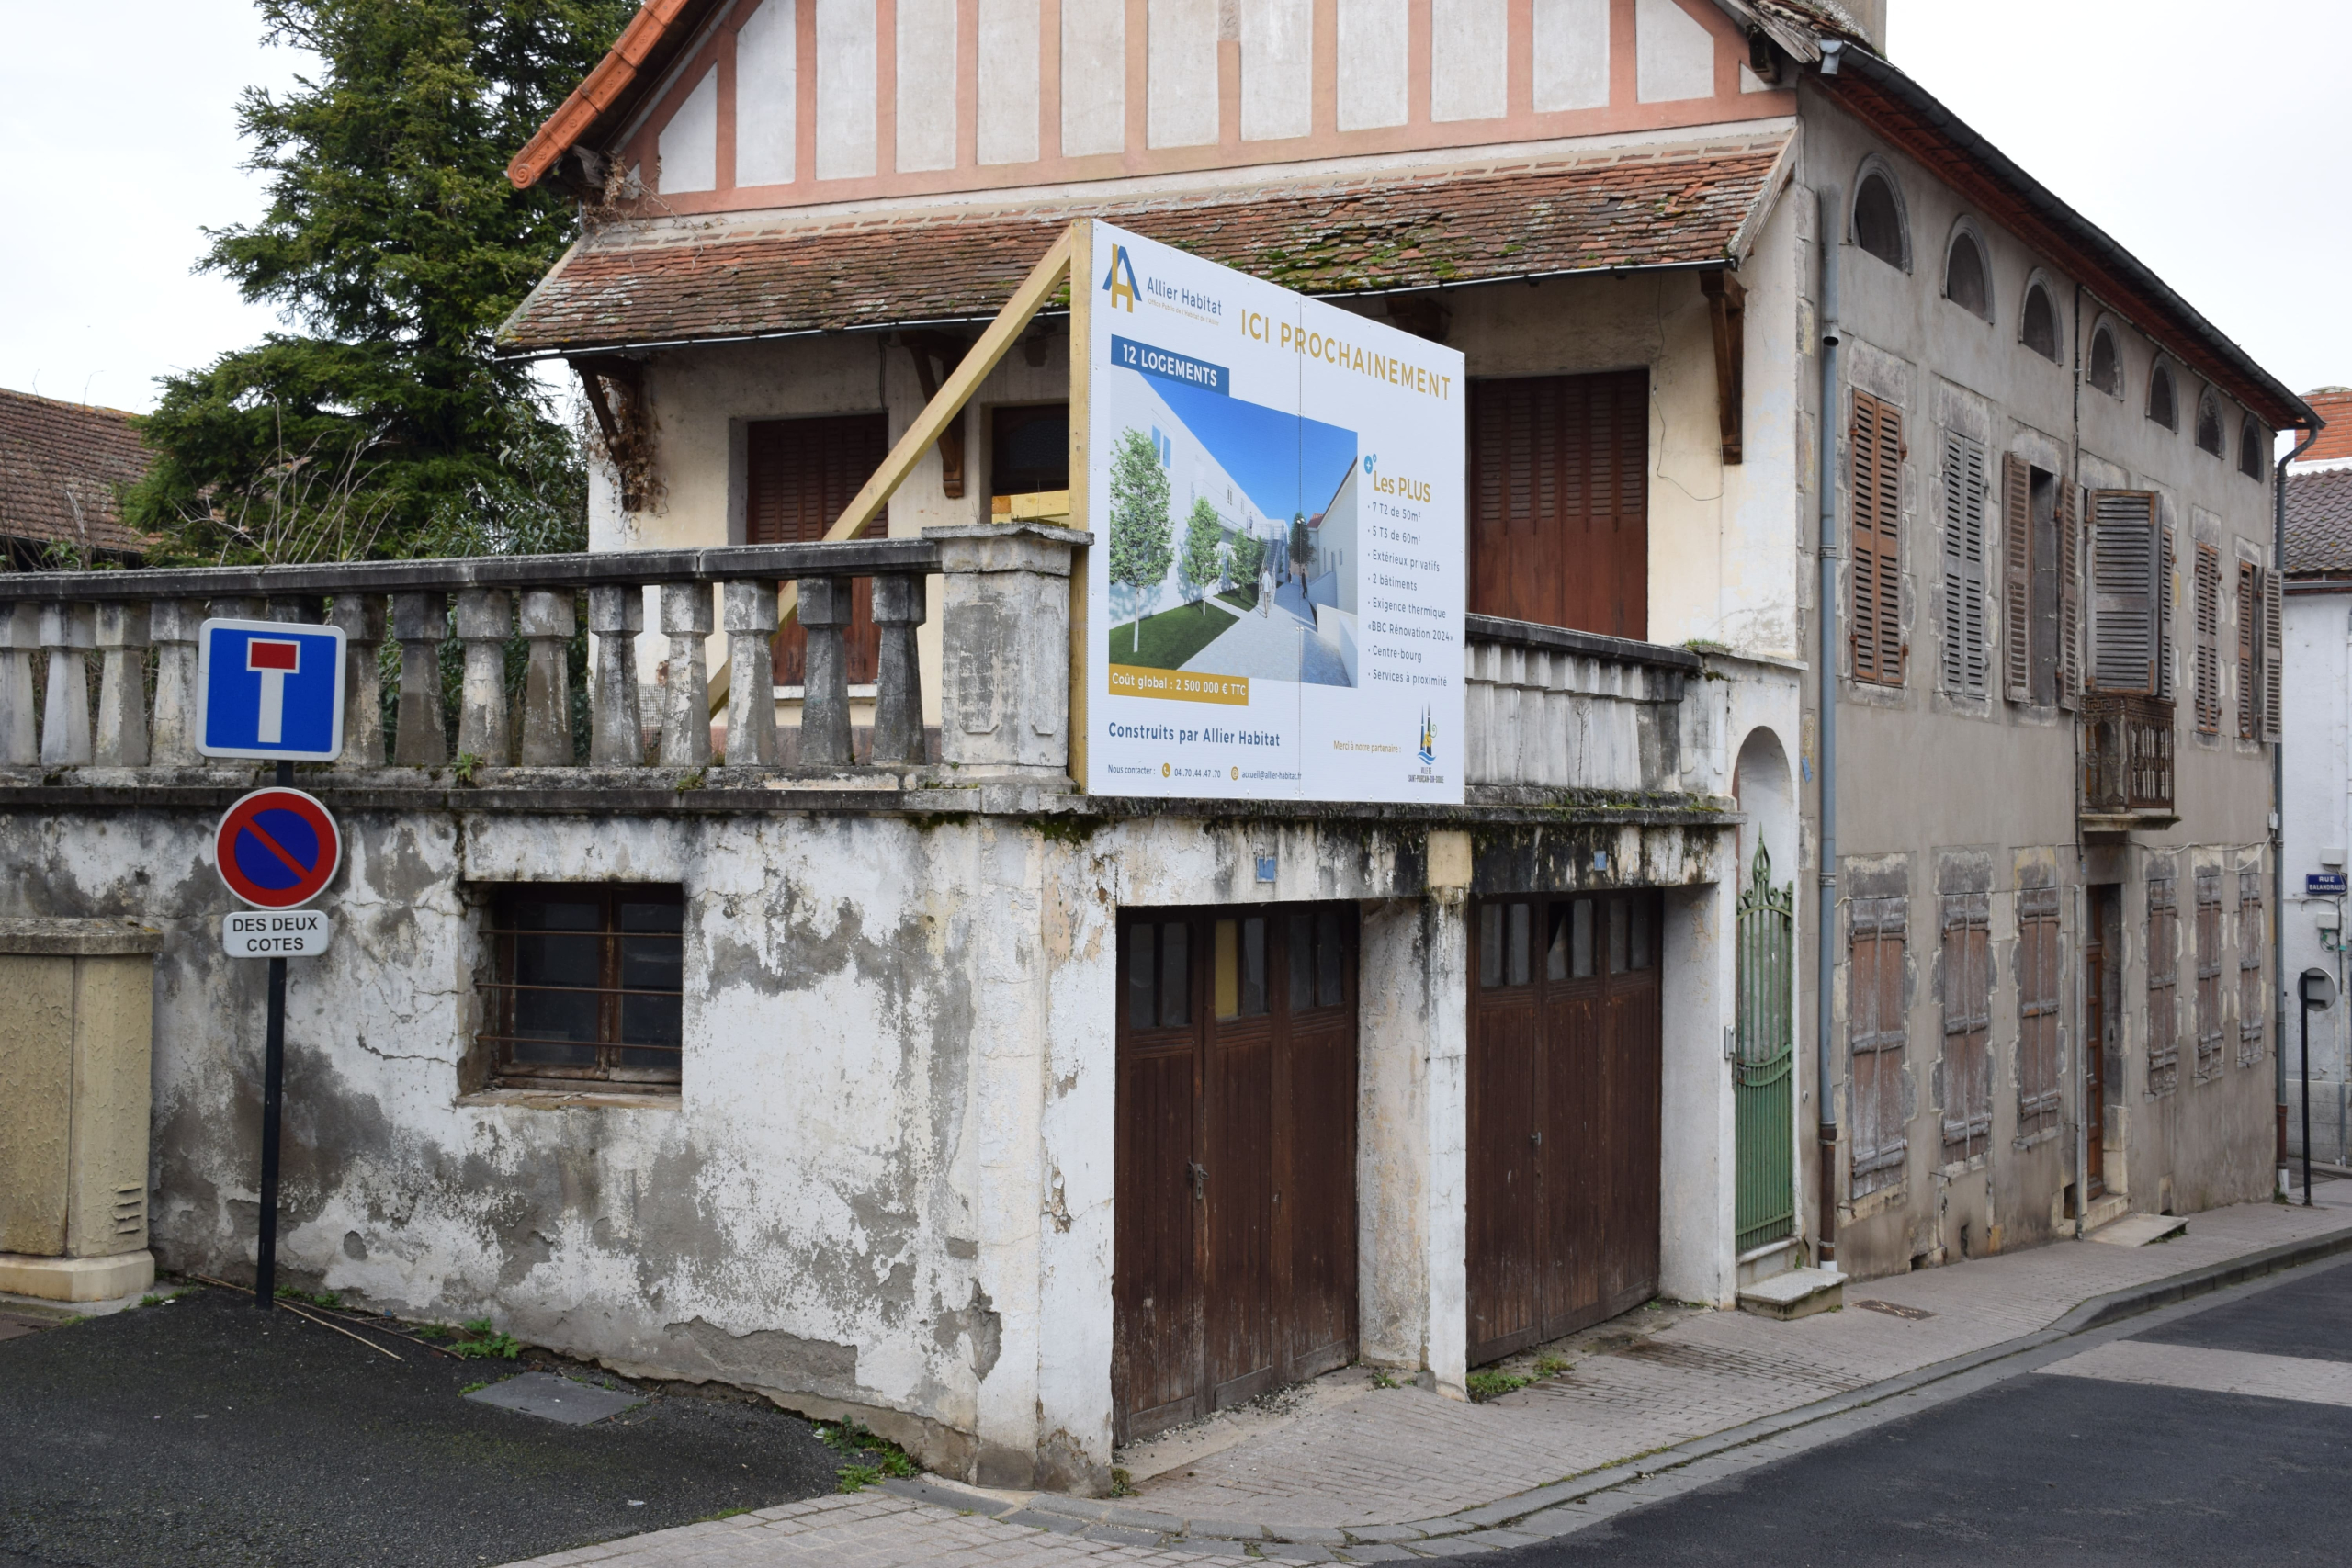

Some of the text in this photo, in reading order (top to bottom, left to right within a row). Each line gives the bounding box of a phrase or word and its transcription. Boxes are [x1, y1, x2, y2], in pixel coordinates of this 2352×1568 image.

[1147, 276, 1222, 316] Allier Habitat
[1148, 299, 1160, 308] Office
[1162, 302, 1175, 312] Public
[1241, 309, 1451, 400] ICI PROCHAINEMENT
[1123, 344, 1217, 387] 12 LOGEMENTS
[1374, 470, 1430, 503] Les PLUS
[1373, 502, 1377, 513] 7
[1379, 502, 1388, 515] T2
[1391, 506, 1400, 518] de
[1373, 525, 1377, 536] 5
[1379, 526, 1388, 539] T3
[1391, 529, 1400, 541] de
[1373, 549, 1441, 573] Extérieux privatifs
[1373, 573, 1418, 592] 2 bâtiments
[1373, 597, 1446, 620] Exigence thermique
[1389, 623, 1430, 639] Rénovation
[1373, 645, 1422, 664] Centre-bourg
[1112, 672, 1135, 686] Coût
[1138, 675, 1168, 690] global
[1176, 679, 1182, 691] 2
[1184, 680, 1201, 693] 500
[1203, 682, 1219, 694] 000
[1222, 683, 1228, 694] €
[1230, 684, 1246, 696] TTC
[1373, 669, 1448, 687] Services à proximité
[1108, 722, 1280, 747] Construits par Allier Habitat
[1333, 740, 1350, 750] Merci
[1351, 741, 1354, 750] à
[1355, 743, 1370, 752] notre
[1371, 743, 1398, 754] partenaire
[1108, 764, 1124, 774] Nous
[1125, 766, 1152, 775] contacter
[1241, 770, 1302, 780] accueil@allier-habitat.fr
[232, 917, 318, 931] DES DEUX
[247, 937, 304, 952] COTES
